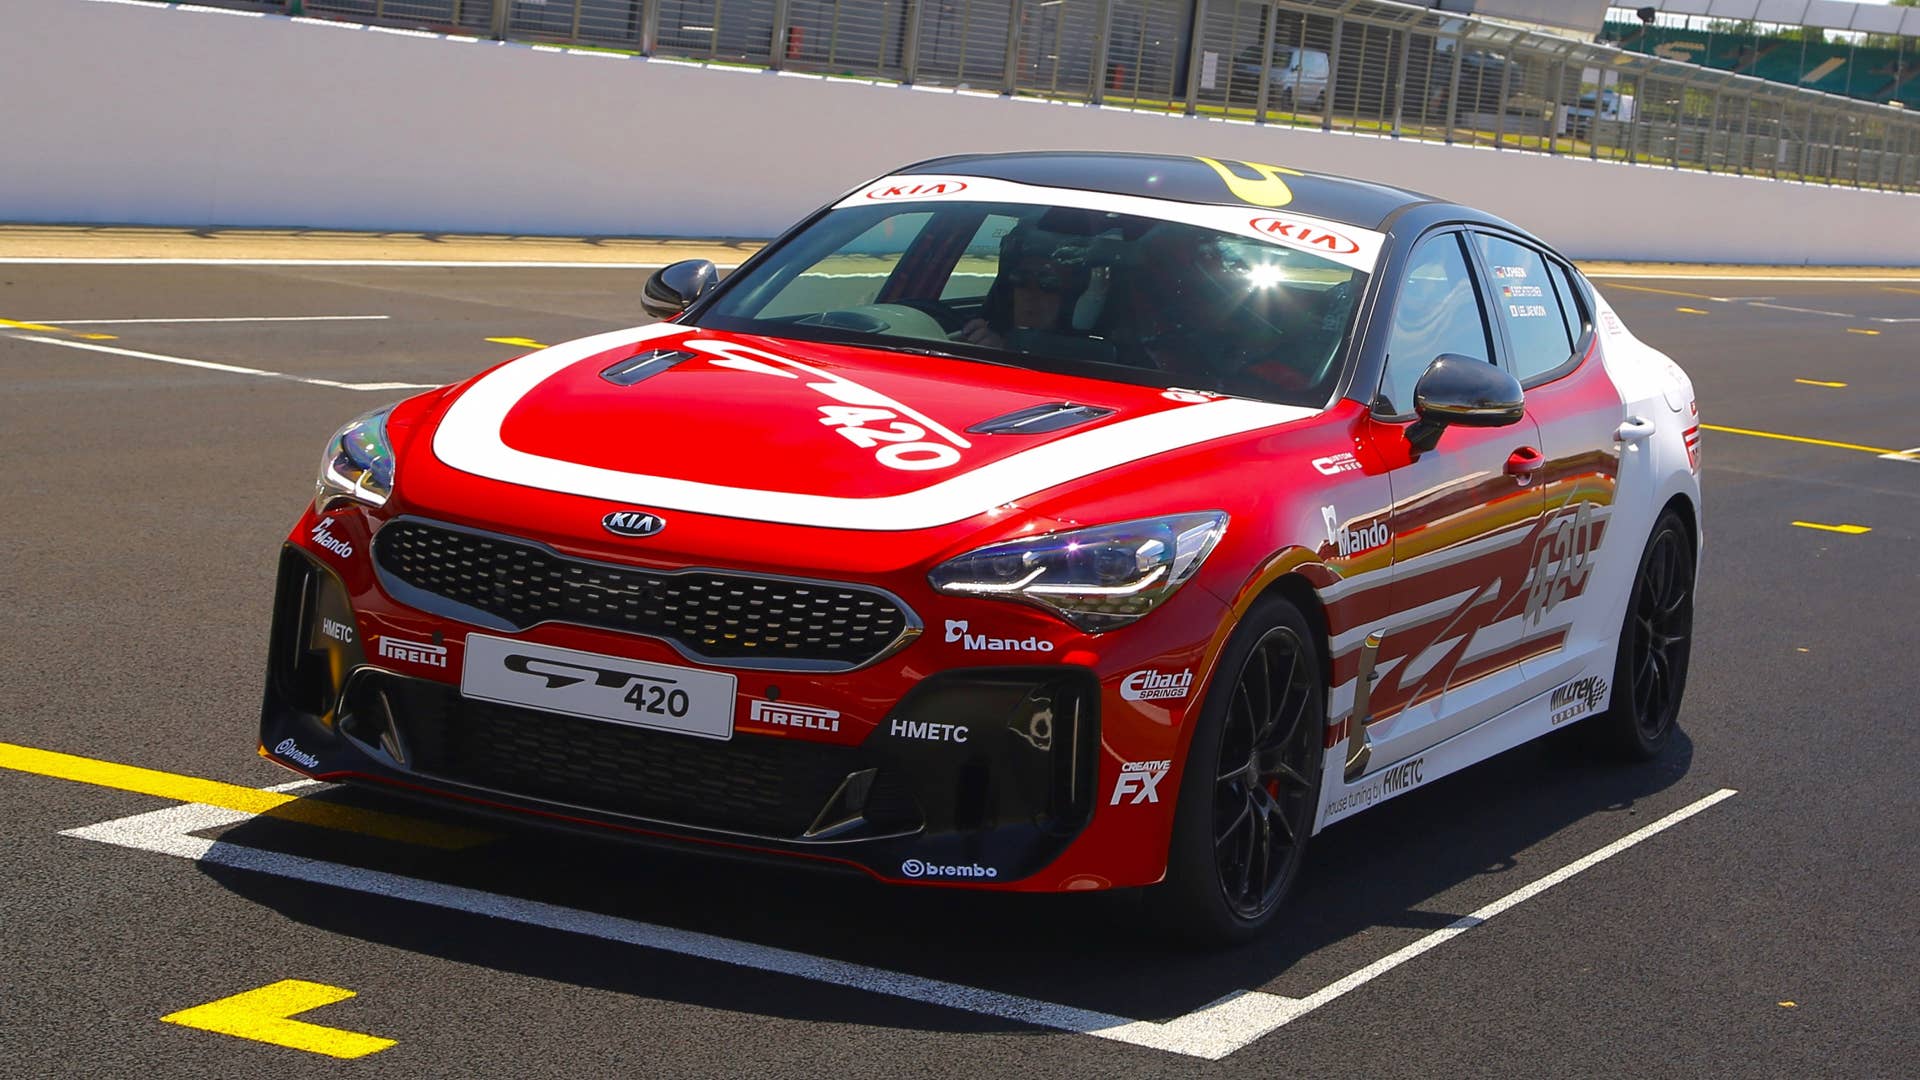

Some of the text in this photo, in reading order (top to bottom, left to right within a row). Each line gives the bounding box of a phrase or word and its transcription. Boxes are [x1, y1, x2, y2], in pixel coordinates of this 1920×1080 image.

[882, 183, 947, 197] KIA
[1267, 221, 1337, 250] KIA
[816, 404, 962, 471] 420
[609, 511, 654, 532] KIA
[312, 528, 354, 559] Mando
[1336, 519, 1389, 556] Mando
[1522, 499, 1592, 628] 420
[322, 617, 353, 643] HMETC
[964, 635, 1055, 653] Mando
[378, 636, 448, 668] PIRELLI
[1119, 668, 1194, 701] Eibach
[1139, 687, 1185, 699] SPRINGS
[623, 684, 690, 718] 420
[750, 699, 840, 732] PIRELLI
[1552, 703, 1585, 724] SPORT
[890, 719, 969, 743] HMETC
[284, 744, 320, 768] brembo
[1121, 760, 1172, 773] CREATIVE
[1110, 769, 1169, 806] FX
[1348, 786, 1373, 807] tuning
[1383, 760, 1424, 794] HMETC
[925, 863, 998, 878] brembo
